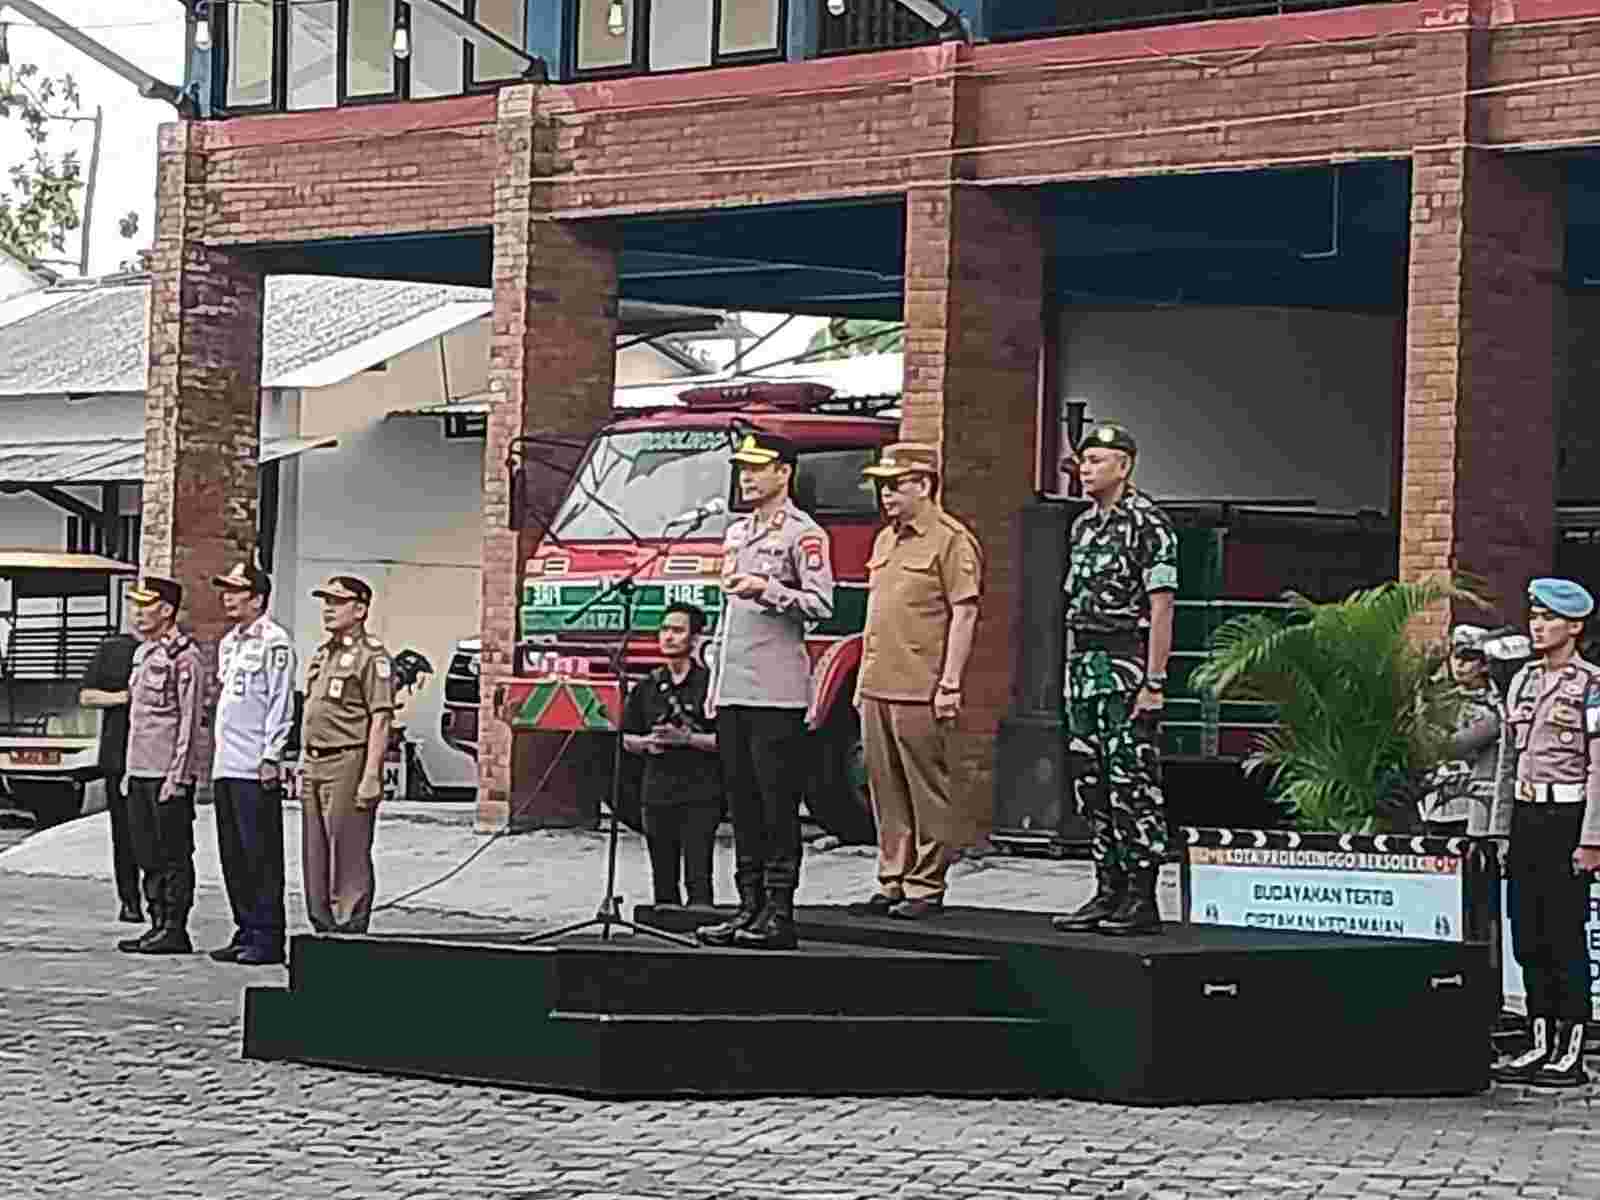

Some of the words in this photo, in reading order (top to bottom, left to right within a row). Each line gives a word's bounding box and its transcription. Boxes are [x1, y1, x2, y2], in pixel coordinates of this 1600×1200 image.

[664, 584, 705, 604] FIRE
[1253, 884, 1341, 904] BUDAYAKAN
[1345, 886, 1393, 906] TERTIB
